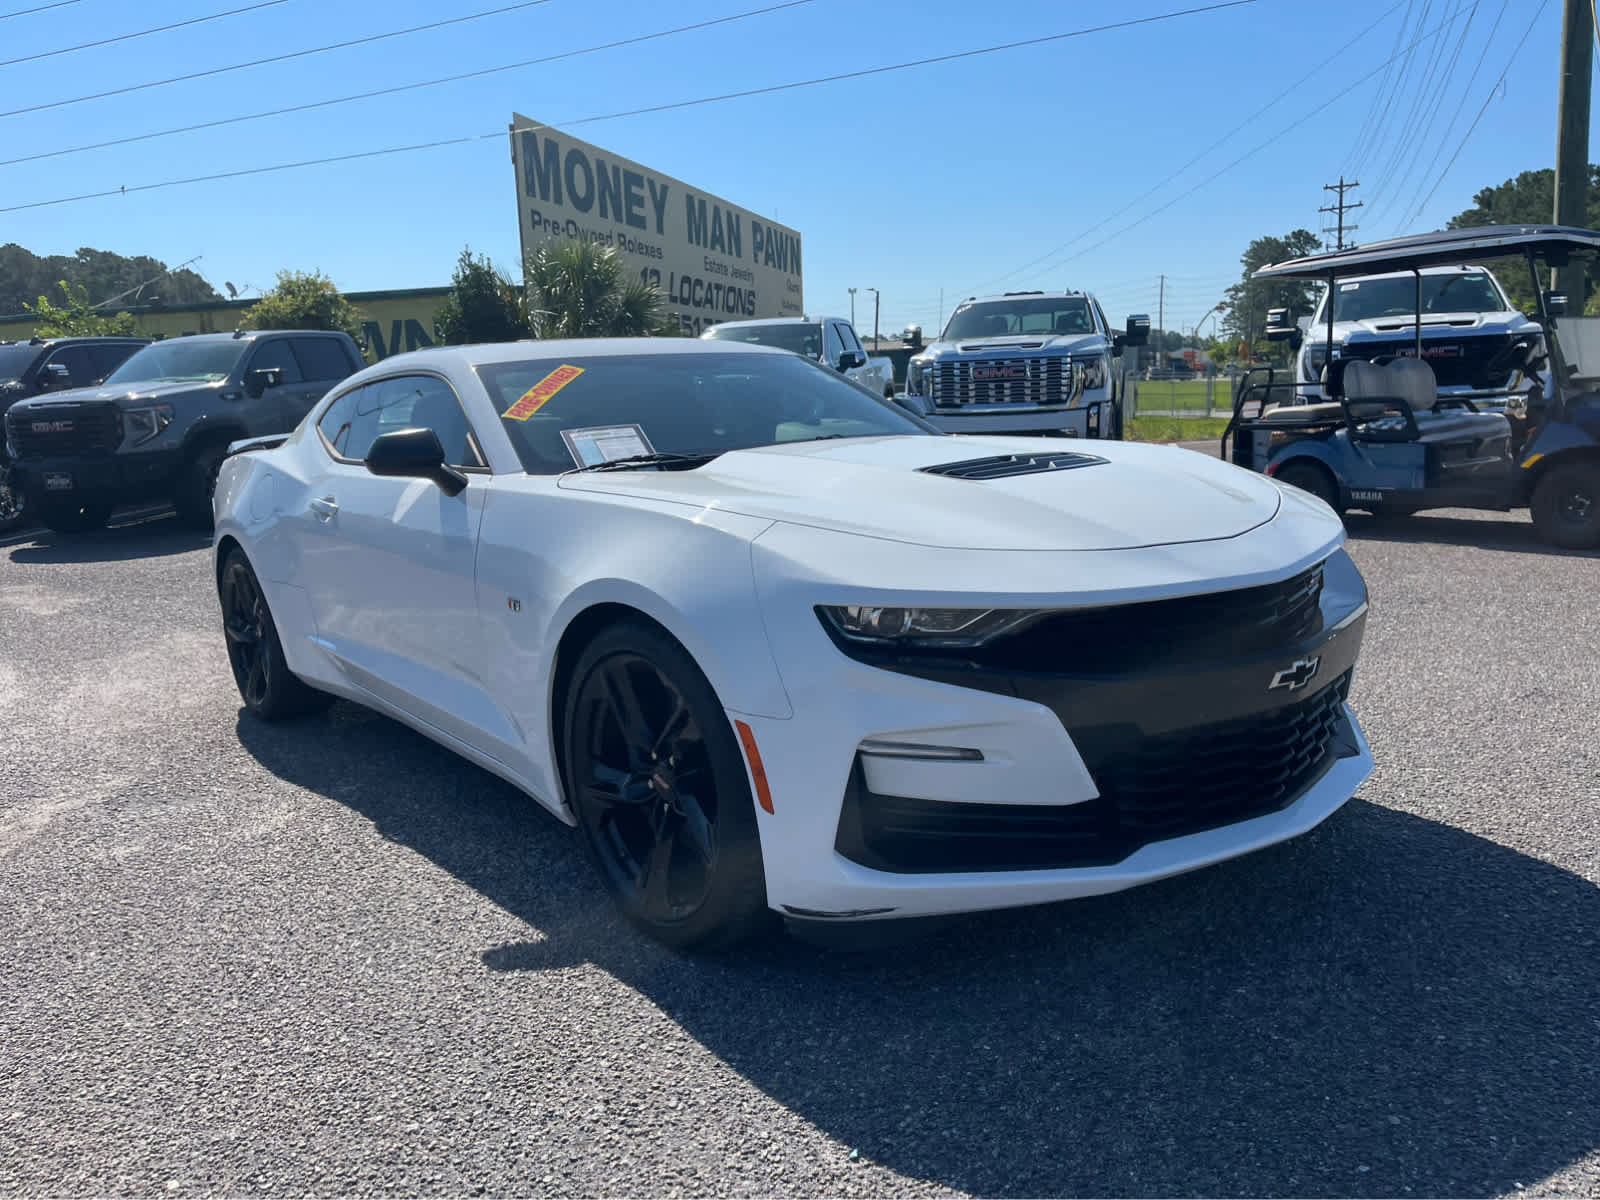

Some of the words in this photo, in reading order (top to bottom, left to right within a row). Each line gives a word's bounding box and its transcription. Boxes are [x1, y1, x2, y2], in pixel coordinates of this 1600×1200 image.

[521, 131, 669, 236] MONEY
[686, 193, 742, 258] MAN
[752, 220, 801, 276] PAWN
[530, 209, 613, 246] Pre-Owned
[617, 231, 665, 260] Rolexes
[703, 255, 729, 275] Estate
[668, 271, 756, 316] LOCATIONS
[975, 366, 1025, 378] GMC
[507, 367, 579, 419] PRE-OWNED
[32, 420, 73, 432] GMC
[1351, 490, 1383, 502] YAMAHA
